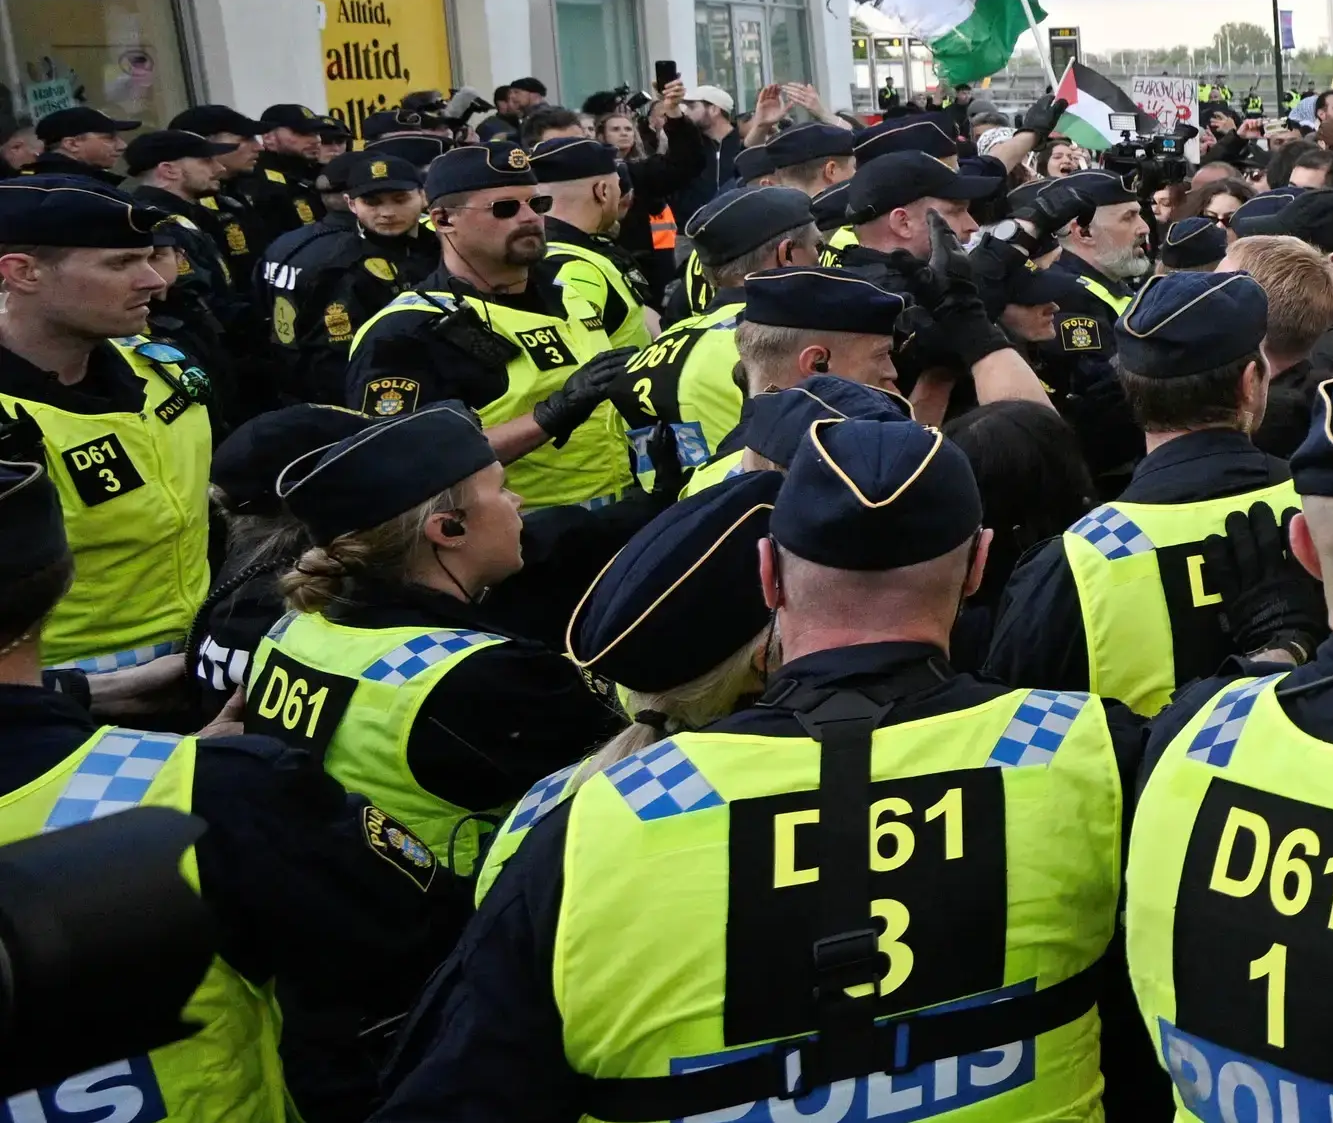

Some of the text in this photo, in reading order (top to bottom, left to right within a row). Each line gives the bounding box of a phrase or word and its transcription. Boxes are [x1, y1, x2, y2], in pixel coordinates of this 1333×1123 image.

[326, 38, 411, 85] alltid,
[522, 329, 558, 348] D61
[1064, 320, 1094, 329] POLIS
[544, 345, 564, 364] 3
[627, 334, 690, 374] D61
[370, 380, 416, 392] POLIS
[632, 377, 658, 417] 3
[159, 396, 185, 420] POLIS
[71, 441, 117, 471] D61
[99, 468, 121, 492] 3
[258, 665, 329, 738] D61
[774, 787, 964, 889] D61
[1249, 942, 1287, 1048] 1
